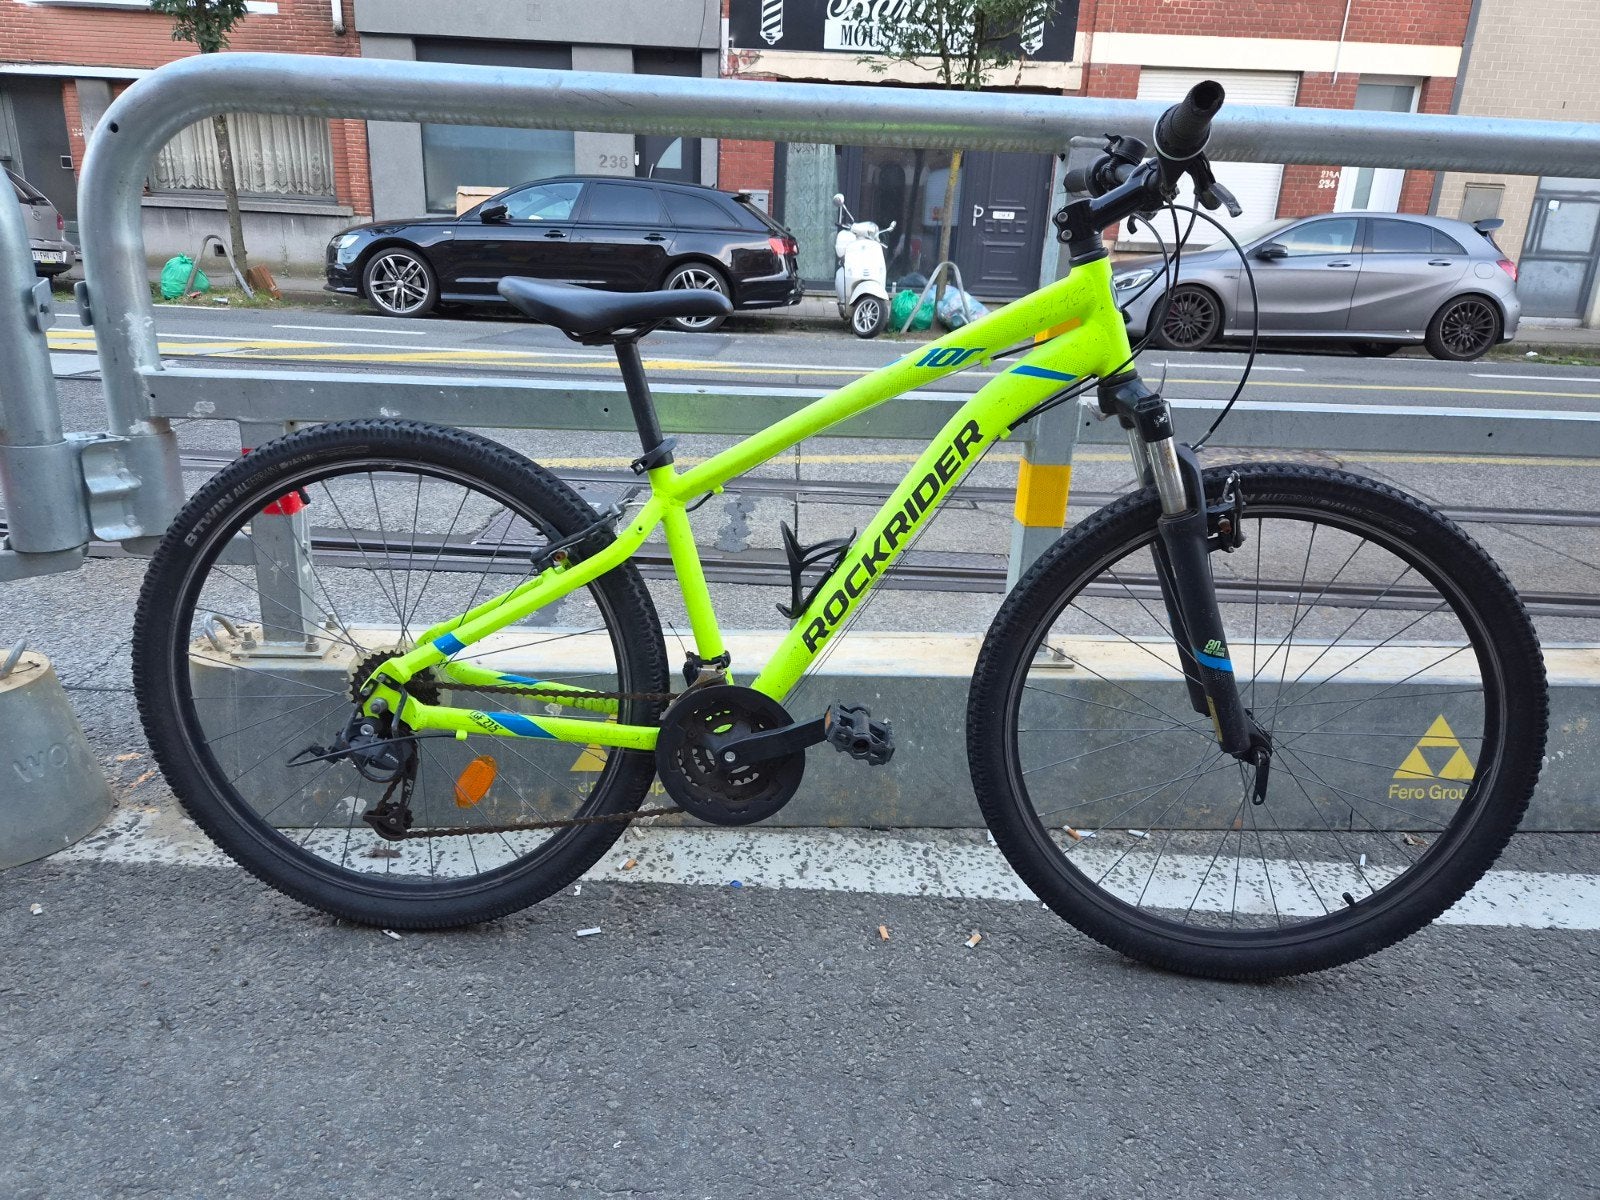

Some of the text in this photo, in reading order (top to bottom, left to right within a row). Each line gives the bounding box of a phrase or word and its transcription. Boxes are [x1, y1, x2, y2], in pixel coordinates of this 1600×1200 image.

[599, 154, 628, 169] 238
[801, 419, 984, 654] ROCKRIDER
[1388, 784, 1468, 799] Fero Grou
